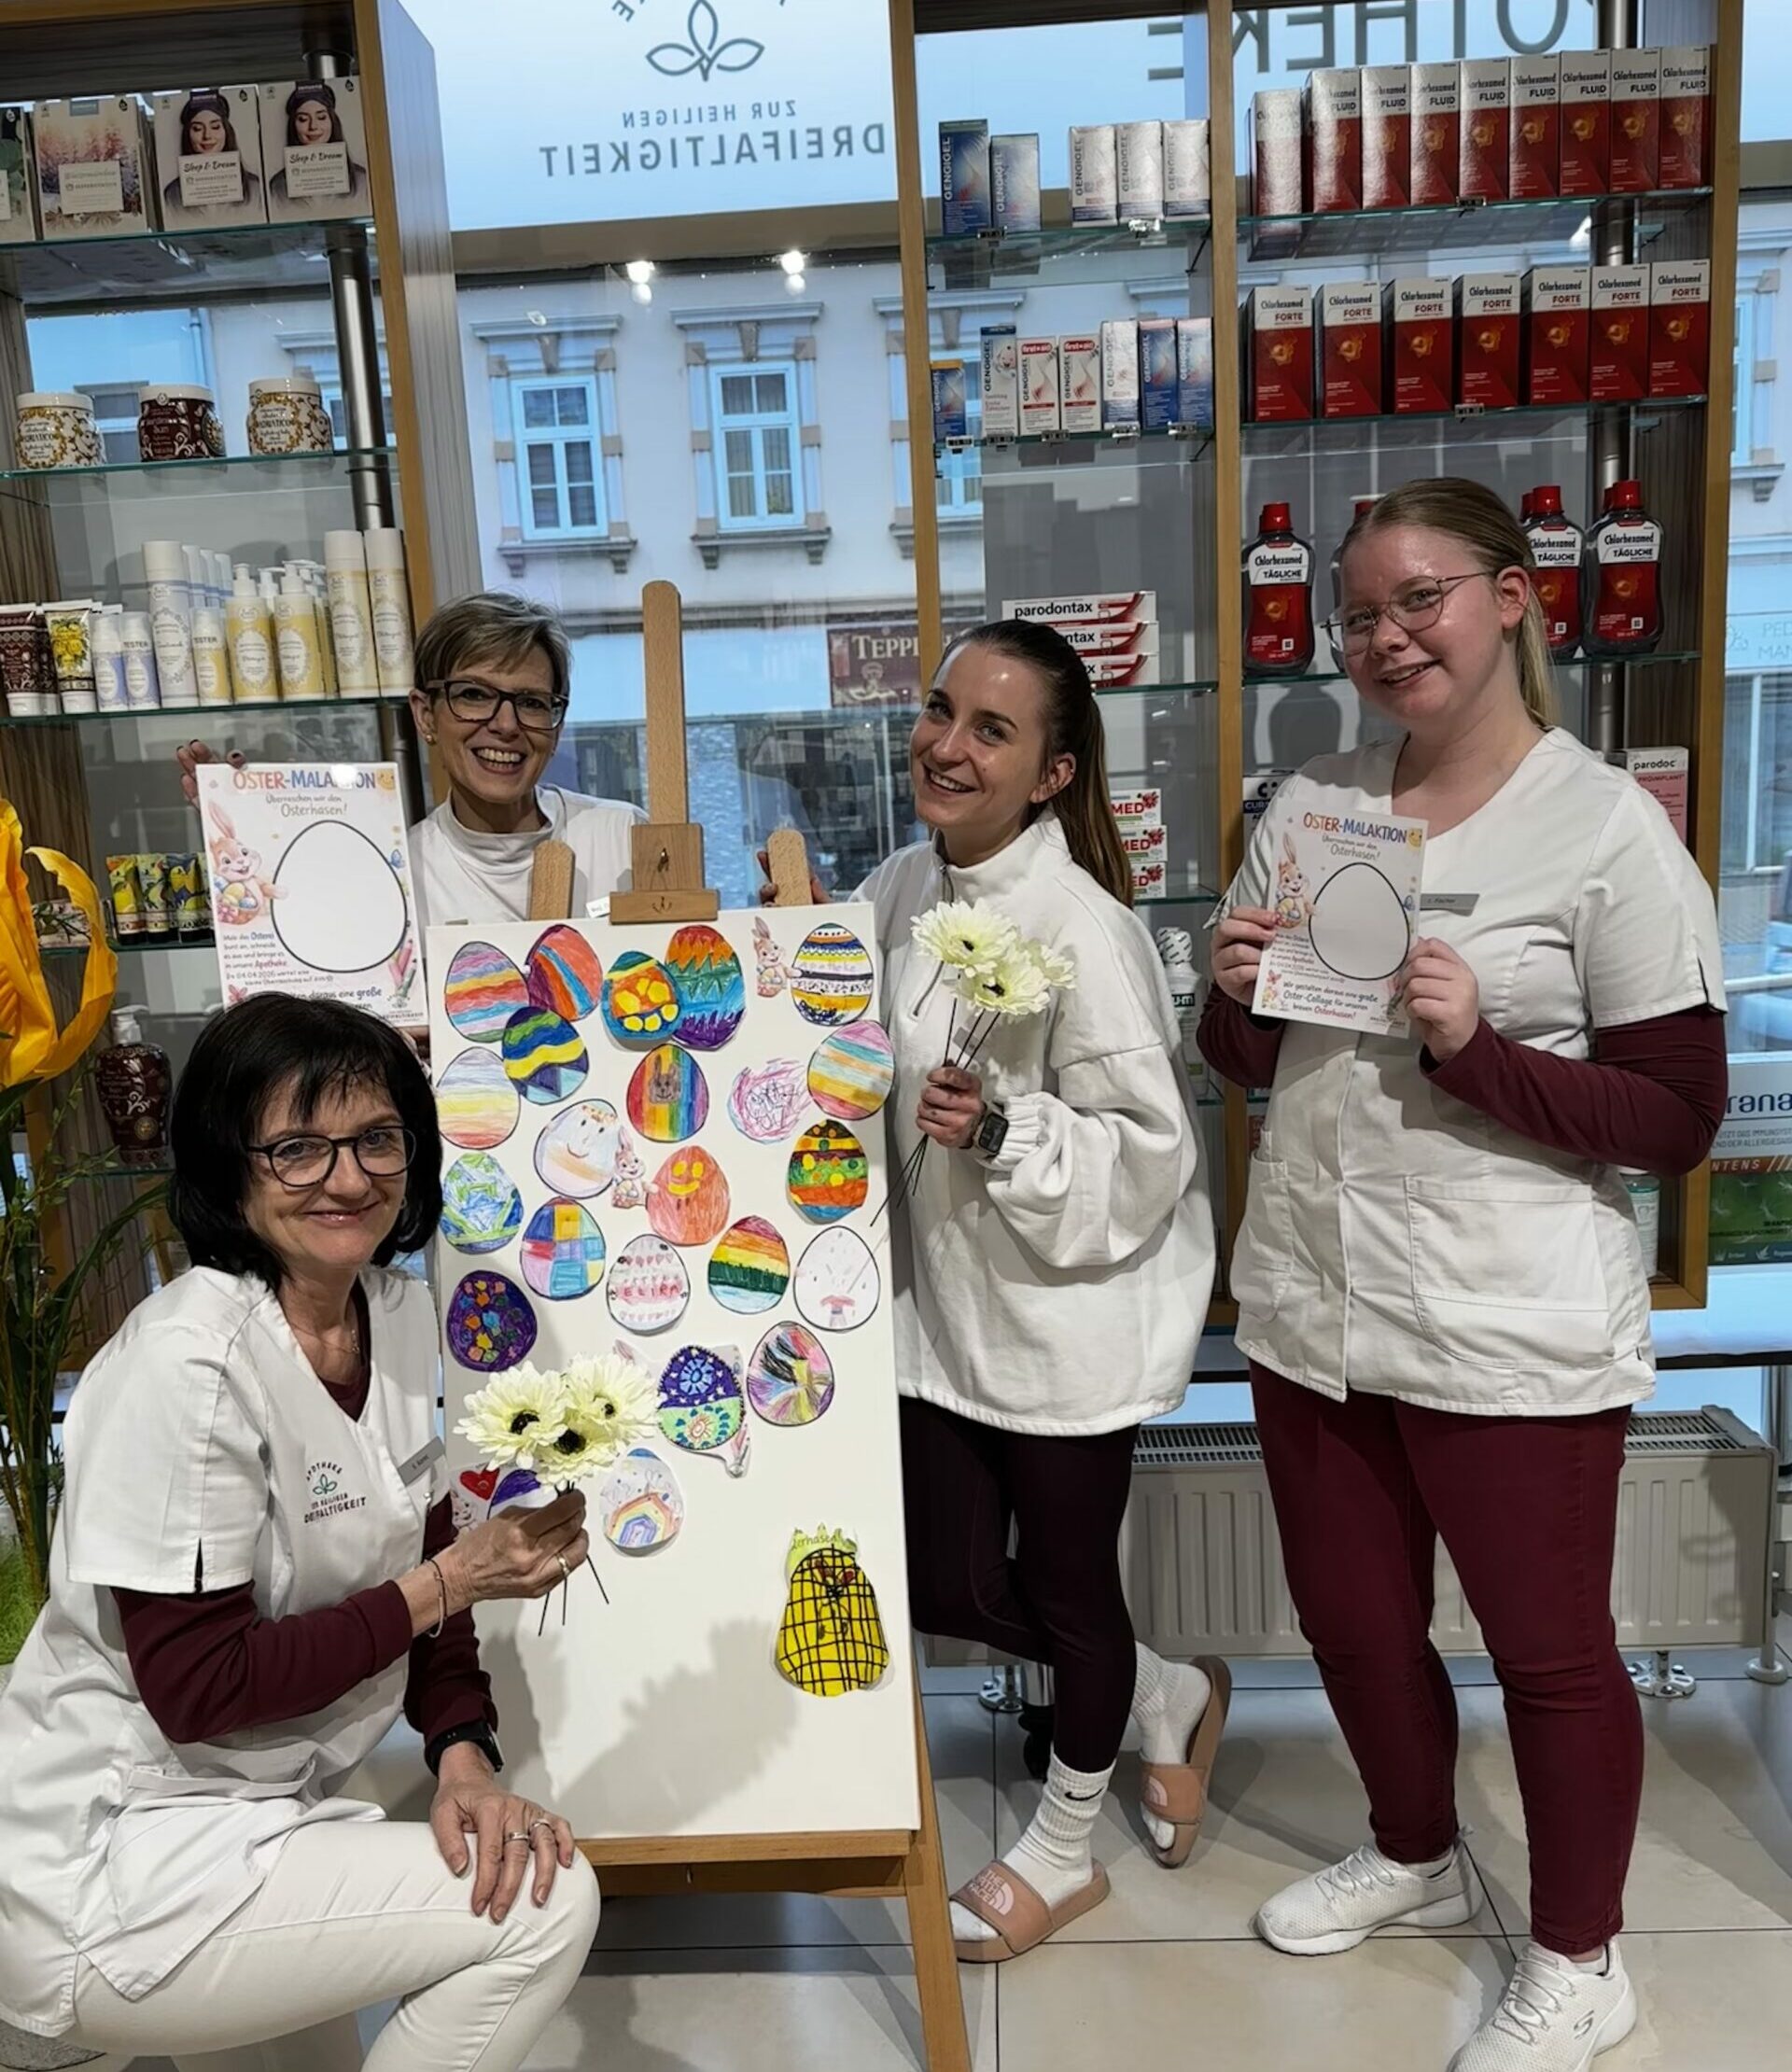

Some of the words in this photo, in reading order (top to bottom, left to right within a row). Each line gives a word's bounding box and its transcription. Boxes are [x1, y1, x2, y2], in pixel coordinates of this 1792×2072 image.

[1562, 70, 1607, 83] Chlorhexamed
[1613, 68, 1658, 81] Chlorhexamed
[1663, 65, 1707, 77] Chlorhexamed
[1580, 85, 1606, 94] FLUID
[1631, 83, 1657, 92] FLUID
[1680, 80, 1706, 90] FLUID
[1479, 91, 1505, 101] FLUID
[1530, 88, 1556, 97] FLUID
[1381, 98, 1406, 107] FLUID
[1430, 96, 1456, 105] FLUID
[1598, 277, 1642, 289] Chlorhexamed
[1658, 273, 1701, 286] Chlorhexamed
[1469, 285, 1512, 297] Chlorhexamed
[1539, 280, 1582, 292] Chlorhexamed
[1401, 289, 1444, 301] Chlorhexamed
[1612, 291, 1641, 301] FORTE
[1672, 287, 1701, 297] FORTE
[1329, 294, 1372, 306] Chlorhexamed
[1483, 299, 1512, 308] FORTE
[1552, 294, 1581, 303] FORTE
[1261, 299, 1303, 310] Chlorhexamed
[1414, 303, 1443, 313] FORTE
[1275, 313, 1303, 321] FORTE
[1343, 308, 1372, 317] FORTE
[1604, 533, 1654, 545] Chlorhexamed
[1537, 553, 1575, 561] TÄGLICHE
[1614, 547, 1653, 557] TÄGLICHE
[1255, 553, 1302, 567] Chlorhexamed
[1264, 569, 1301, 579] TÄGLICHE
[1015, 603, 1093, 620] parodontax
[1633, 759, 1677, 771] parodoc
[233, 770, 376, 790] OSTER-MALAON
[281, 804, 347, 817] Osterhasen!
[1304, 812, 1407, 843] OSTER-MALAKTION
[1331, 844, 1380, 860] Osterhasen!
[357, 987, 382, 1000] große
